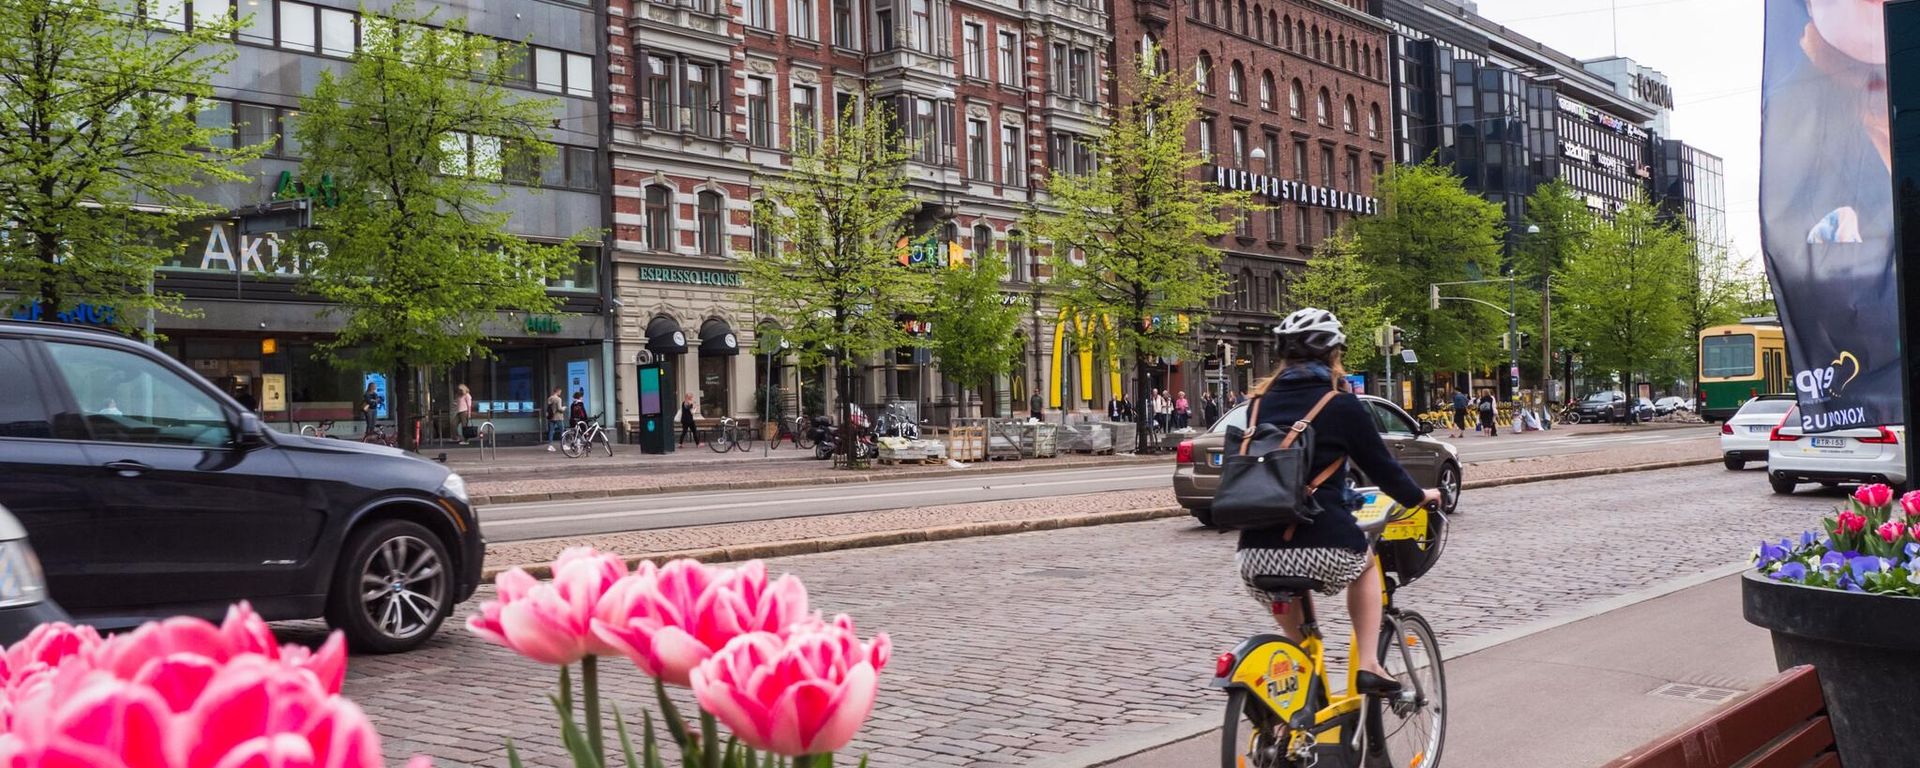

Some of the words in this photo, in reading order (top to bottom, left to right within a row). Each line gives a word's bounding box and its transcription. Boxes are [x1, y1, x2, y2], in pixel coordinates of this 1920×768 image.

[1637, 73, 1674, 111] FORUM
[1565, 141, 1590, 163] stadium
[1217, 166, 1379, 215] HUFVUDSTADSBLADET
[640, 266, 700, 284] ESPRESSO
[1267, 675, 1298, 698] FILLARI
